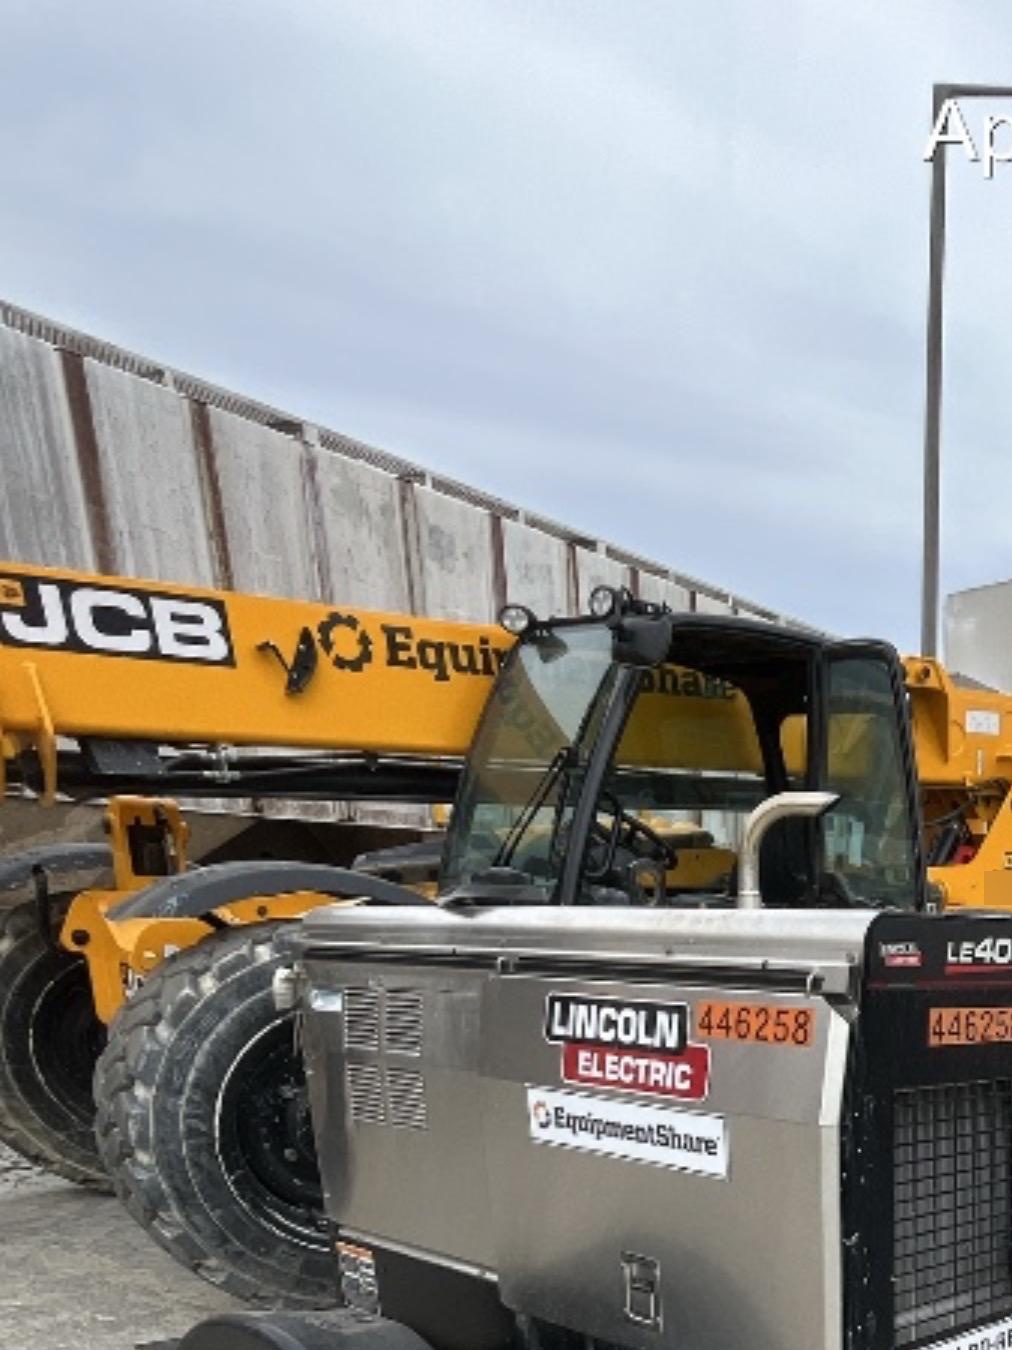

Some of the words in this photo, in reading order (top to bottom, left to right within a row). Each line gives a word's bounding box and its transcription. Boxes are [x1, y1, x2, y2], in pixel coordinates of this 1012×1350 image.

[2, 584, 229, 660] JCB
[551, 1000, 680, 1049] LINCOLN
[698, 1004, 811, 1046] 446258
[577, 1050, 693, 1090] ELECTRIC
[554, 1106, 719, 1157] EquipmentShare
